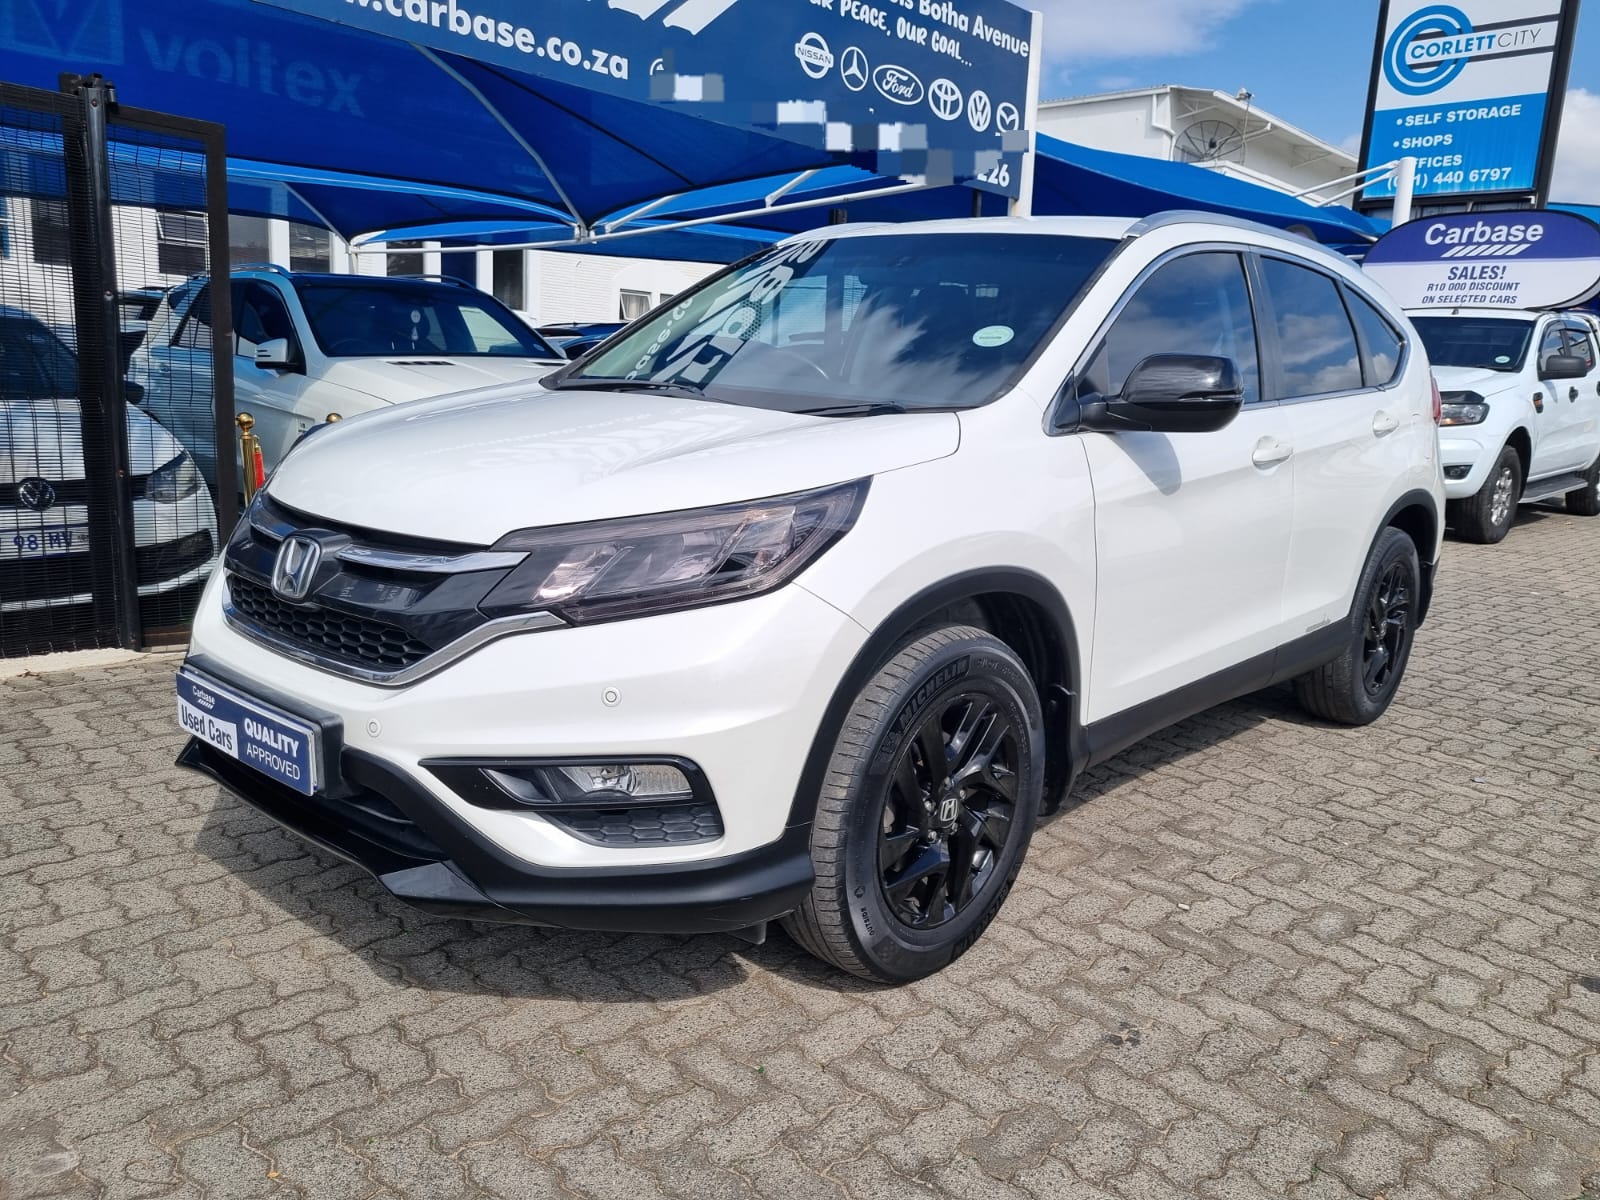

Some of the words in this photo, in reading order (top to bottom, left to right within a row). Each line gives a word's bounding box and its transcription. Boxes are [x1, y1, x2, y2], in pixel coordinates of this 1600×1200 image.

[345, 0, 629, 80] .carbase.co.za
[896, 16, 926, 46] OUR
[919, 0, 969, 32] Botha
[972, 15, 1030, 58] Avenue
[138, 26, 367, 119] voltex
[796, 46, 832, 65] NISSAN
[882, 70, 915, 98] Ford
[1404, 112, 1443, 127] SELF
[1446, 104, 1522, 123] STORAGE
[1401, 133, 1453, 149] SHOPS
[977, 158, 1010, 187] 26
[1415, 154, 1463, 169] FICES
[1433, 170, 1464, 185] 440
[1469, 166, 1512, 183] 6797
[1425, 221, 1544, 246] Carbase
[1427, 282, 1446, 292] R10
[1448, 282, 1467, 291] 000
[1469, 281, 1520, 291] DISCOUNT
[1448, 265, 1507, 281] SALES!
[1421, 295, 1436, 304] ON
[1437, 294, 1487, 304] SELECTED
[1489, 295, 1517, 304] CARS
[192, 685, 216, 705] Carbase
[899, 660, 967, 726] MICHELIN
[181, 703, 206, 735] Used
[208, 719, 233, 752] Cars
[243, 717, 300, 758] QUALITY
[246, 743, 300, 781] APPROVED
